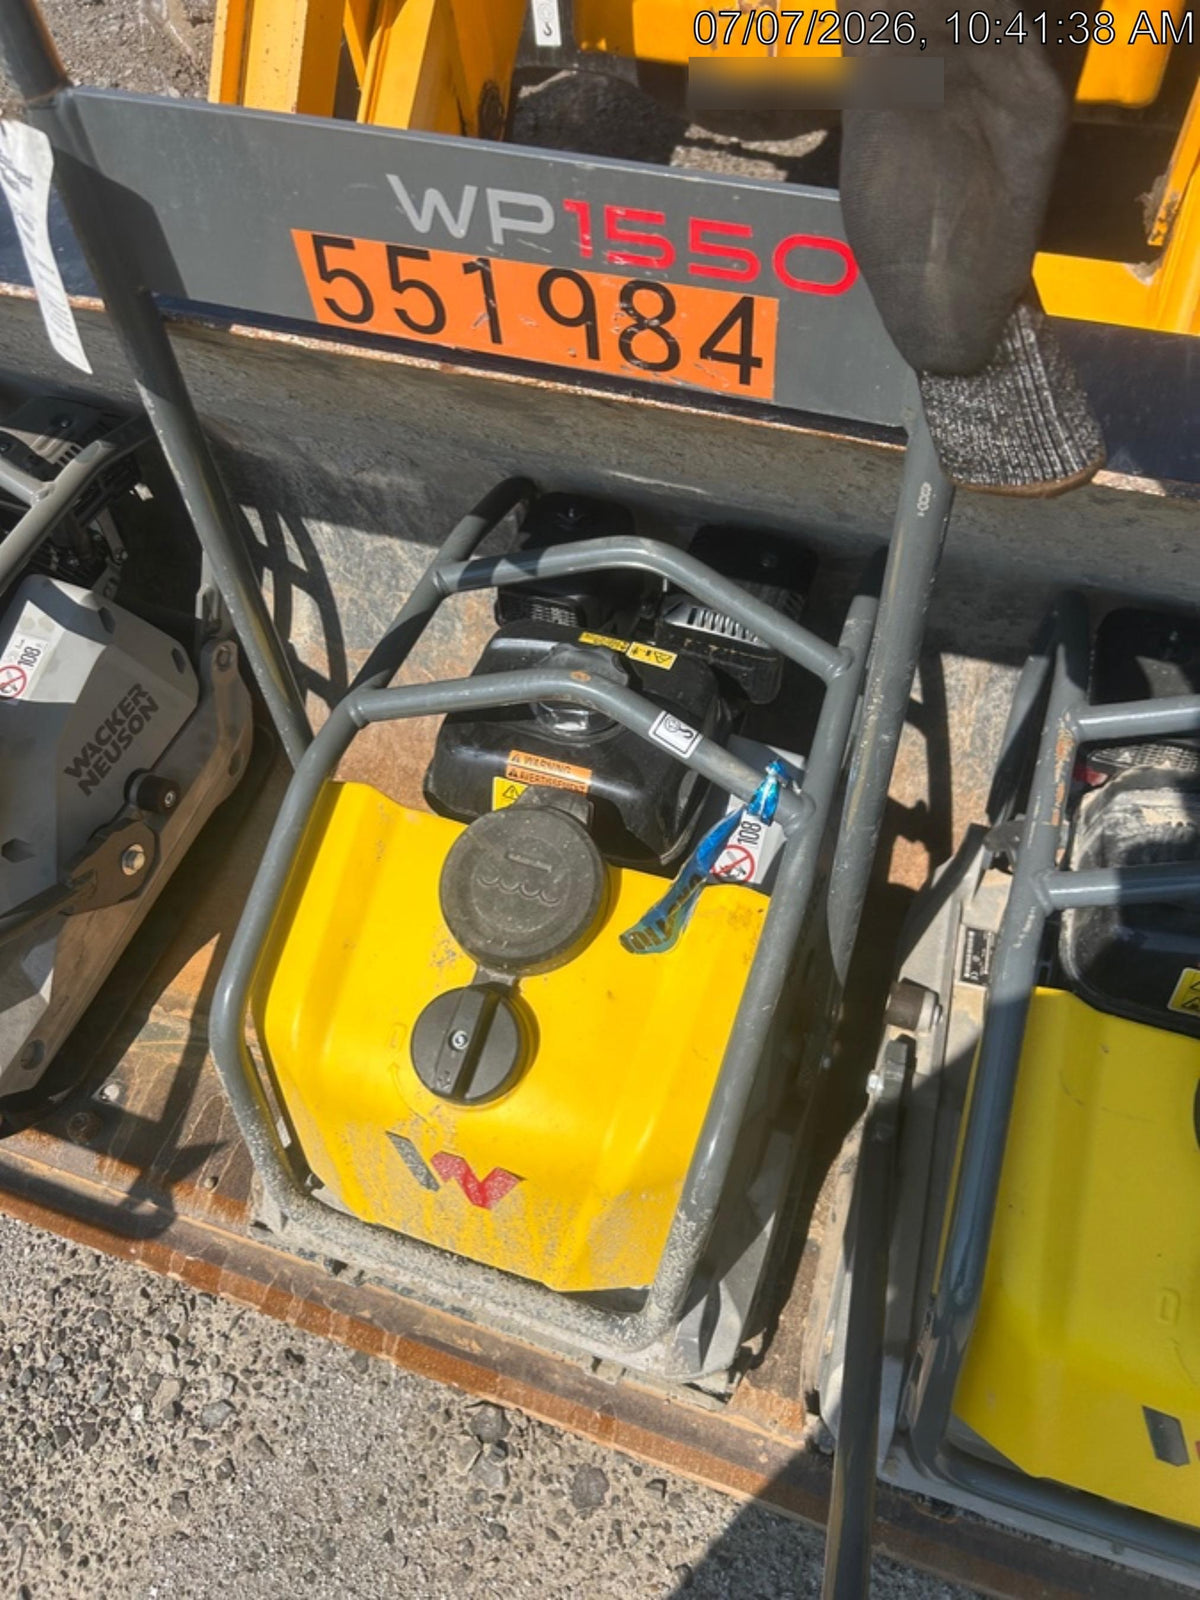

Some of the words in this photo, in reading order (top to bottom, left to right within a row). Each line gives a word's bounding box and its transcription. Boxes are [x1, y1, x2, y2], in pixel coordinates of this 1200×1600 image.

[386, 173, 859, 296] WP1550
[311, 233, 762, 386] 551984
[17, 646, 41, 668] 108
[64, 683, 149, 779] WACKER
[77, 694, 160, 797] NEUSON
[737, 821, 763, 846] 108
